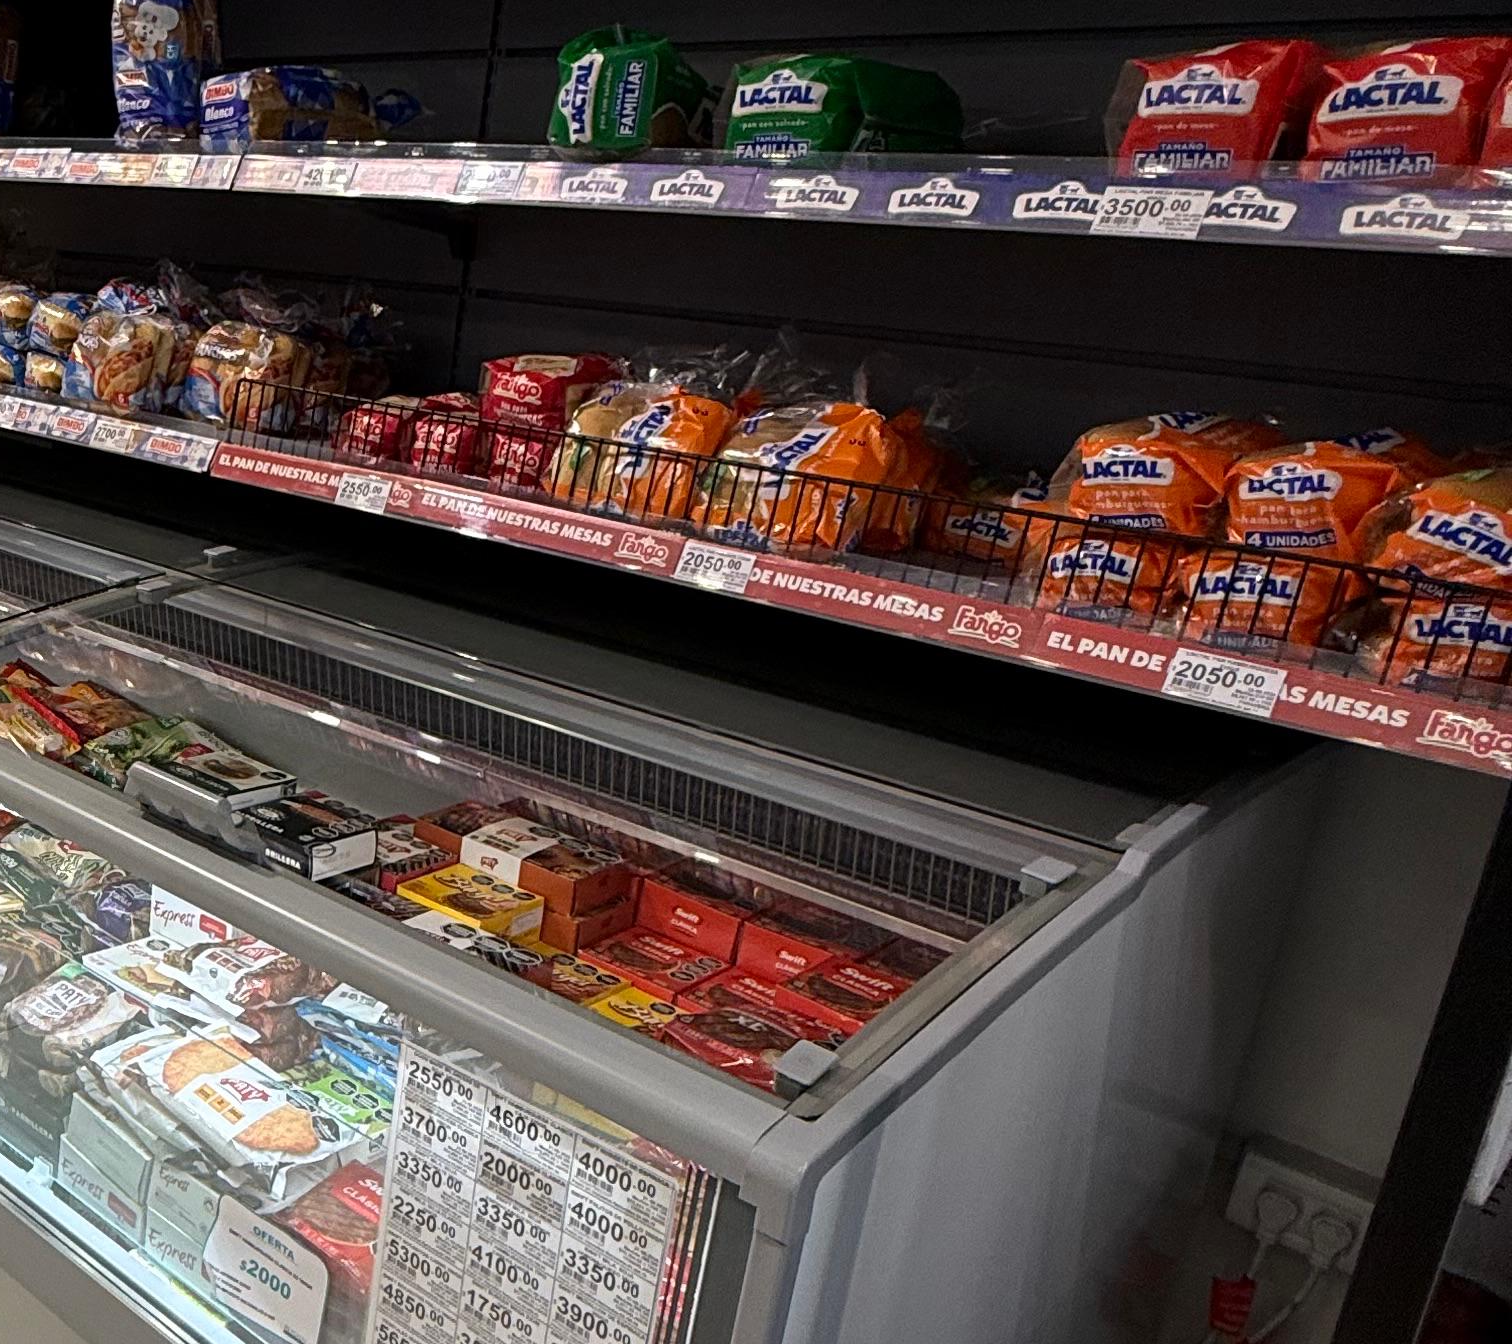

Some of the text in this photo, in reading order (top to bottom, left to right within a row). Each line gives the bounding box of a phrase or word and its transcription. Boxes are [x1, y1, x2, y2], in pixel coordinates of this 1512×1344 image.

[572, 60, 596, 135] LACTAL
[619, 61, 644, 136] FAMILIAR
[739, 85, 817, 108] LACTAL
[1145, 83, 1244, 108] LACTAL
[1328, 81, 1446, 113] LACTAL
[205, 105, 234, 122] Blanco
[736, 143, 808, 159] FAMILIAR
[1320, 156, 1433, 179] FAMILIAR
[567, 177, 621, 199] LACTAL
[658, 179, 716, 200] LACTAL
[783, 185, 849, 207] LACTAL
[897, 189, 969, 211] LACTAL
[1022, 194, 1099, 215] LACTAL
[1204, 202, 1281, 223] ACTAL
[1353, 211, 1456, 233] LACTAL
[149, 436, 183, 455] BIMBO
[219, 453, 233, 467] EL
[232, 457, 255, 472] PAN
[255, 461, 270, 475] DE
[271, 464, 328, 486] NUESTRAS
[1082, 459, 1165, 480] LACTAL
[421, 492, 437, 507] EL
[438, 496, 466, 514] PAN
[467, 503, 487, 518] DE
[488, 508, 560, 536] NUESTRAS
[559, 524, 613, 548] MESAS
[1247, 529, 1336, 548] 4 UNIDADES
[683, 552, 742, 572] 2050.00
[1050, 552, 1129, 578] LACTAL
[1199, 574, 1294, 599] LACTAL
[750, 567, 772, 585] DE
[773, 574, 874, 607] NUESTRAS
[873, 593, 944, 623] MESAS
[952, 605, 1023, 645] Fargo
[1046, 631, 1074, 652] EL
[1077, 638, 1130, 666] PAN
[1132, 650, 1168, 673] DE
[1311, 690, 1410, 728] MESAS
[153, 900, 197, 928] Express
[779, 949, 808, 968] Swift
[739, 977, 776, 998] Swif
[61, 1157, 105, 1200] Express
[147, 1230, 198, 1272] Express
[252, 1225, 296, 1260] OFERTA
[238, 1259, 292, 1301] $2000
